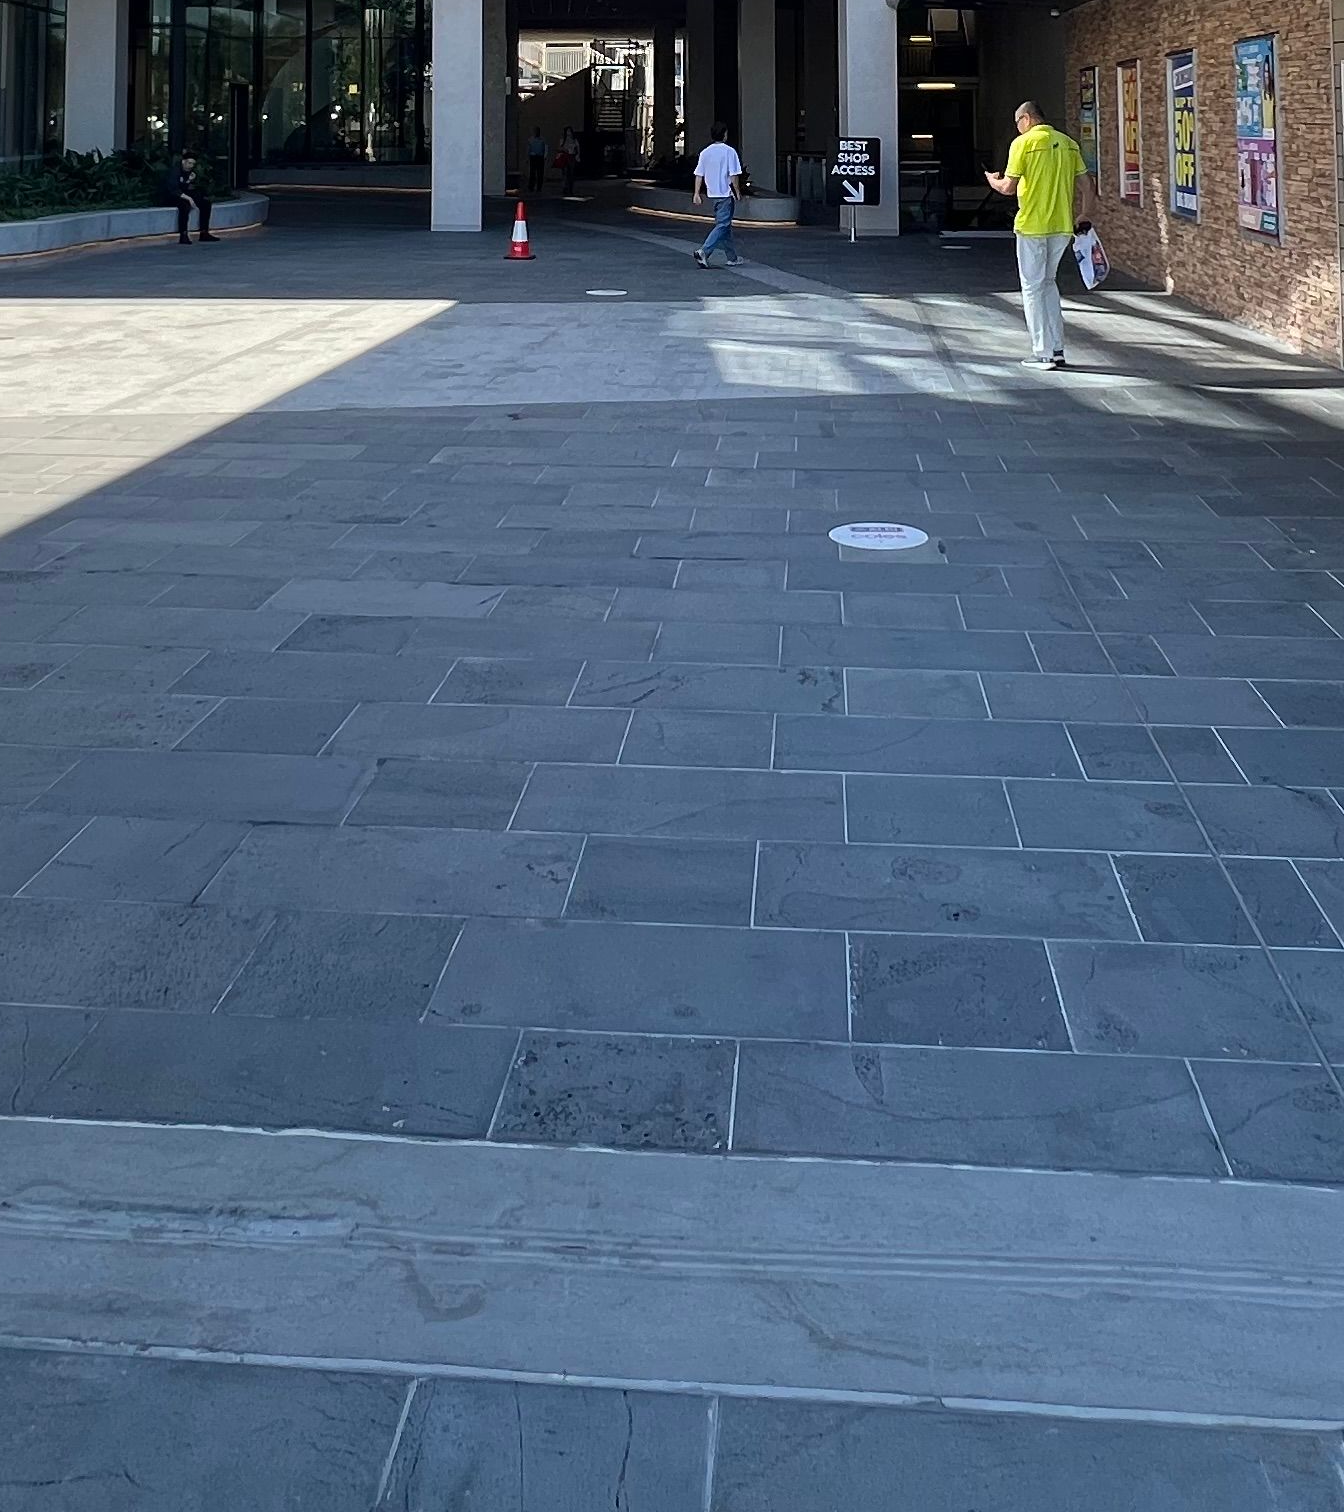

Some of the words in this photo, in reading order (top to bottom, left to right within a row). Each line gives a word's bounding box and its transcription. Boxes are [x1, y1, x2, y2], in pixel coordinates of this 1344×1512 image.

[839, 140, 869, 151] BEST
[837, 152, 870, 163] SHOP
[830, 164, 876, 176] ACCESS
